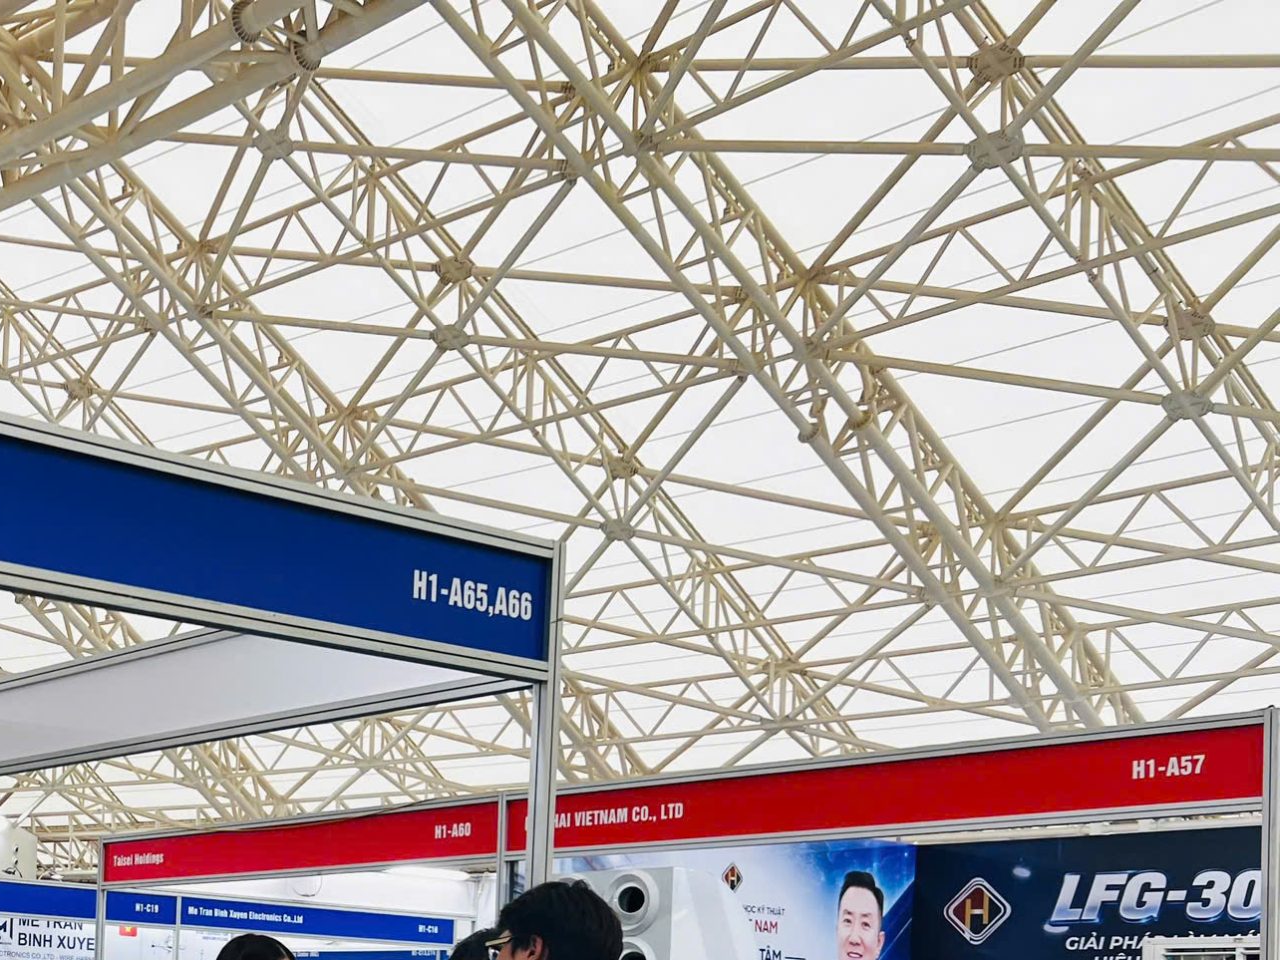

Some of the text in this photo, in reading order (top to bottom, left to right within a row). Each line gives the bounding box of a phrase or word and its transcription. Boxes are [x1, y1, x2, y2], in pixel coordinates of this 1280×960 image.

[412, 569, 533, 621] H1-A65,A66
[1132, 754, 1206, 780] H1-A57
[574, 803, 684, 827] VIETNAM CO., LTD
[434, 822, 471, 839] H1-A60
[113, 851, 164, 867] Taisei Holdings
[754, 920, 778, 934] NAM
[18, 932, 53, 948] BINH
[1065, 931, 1105, 951] GIẢI
